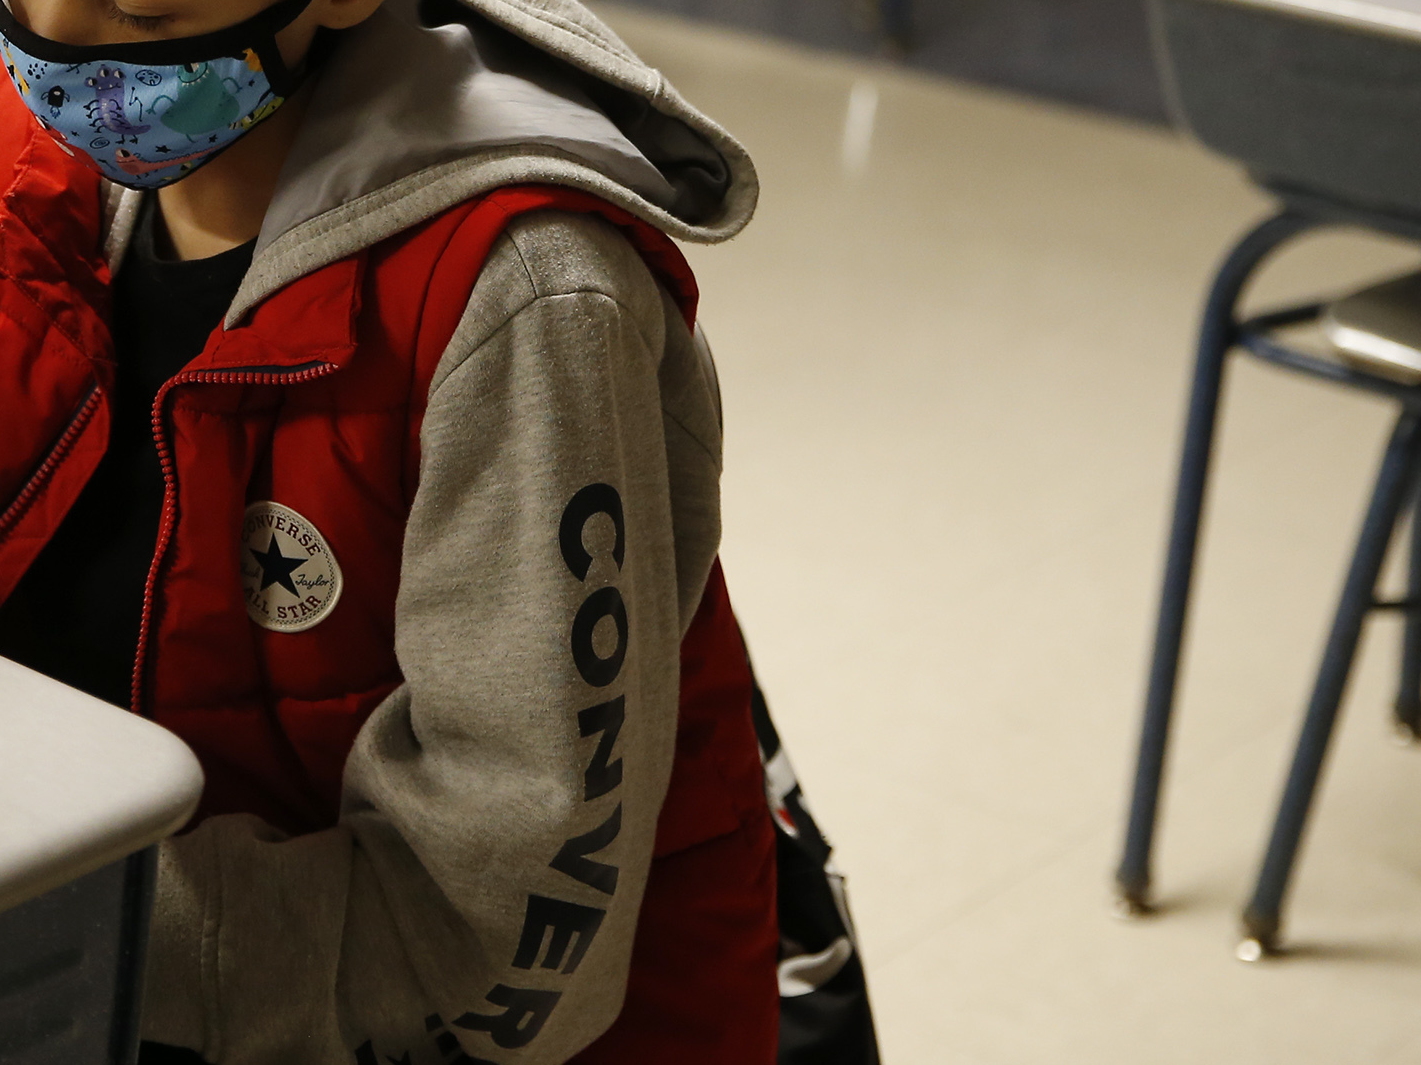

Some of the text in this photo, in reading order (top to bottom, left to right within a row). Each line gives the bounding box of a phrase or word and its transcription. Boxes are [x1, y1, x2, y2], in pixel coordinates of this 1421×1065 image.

[242, 515, 321, 556] CONVERSE
[295, 574, 330, 589] Taylor
[245, 587, 321, 619] ALL STAR
[451, 483, 628, 1065] CONVER
